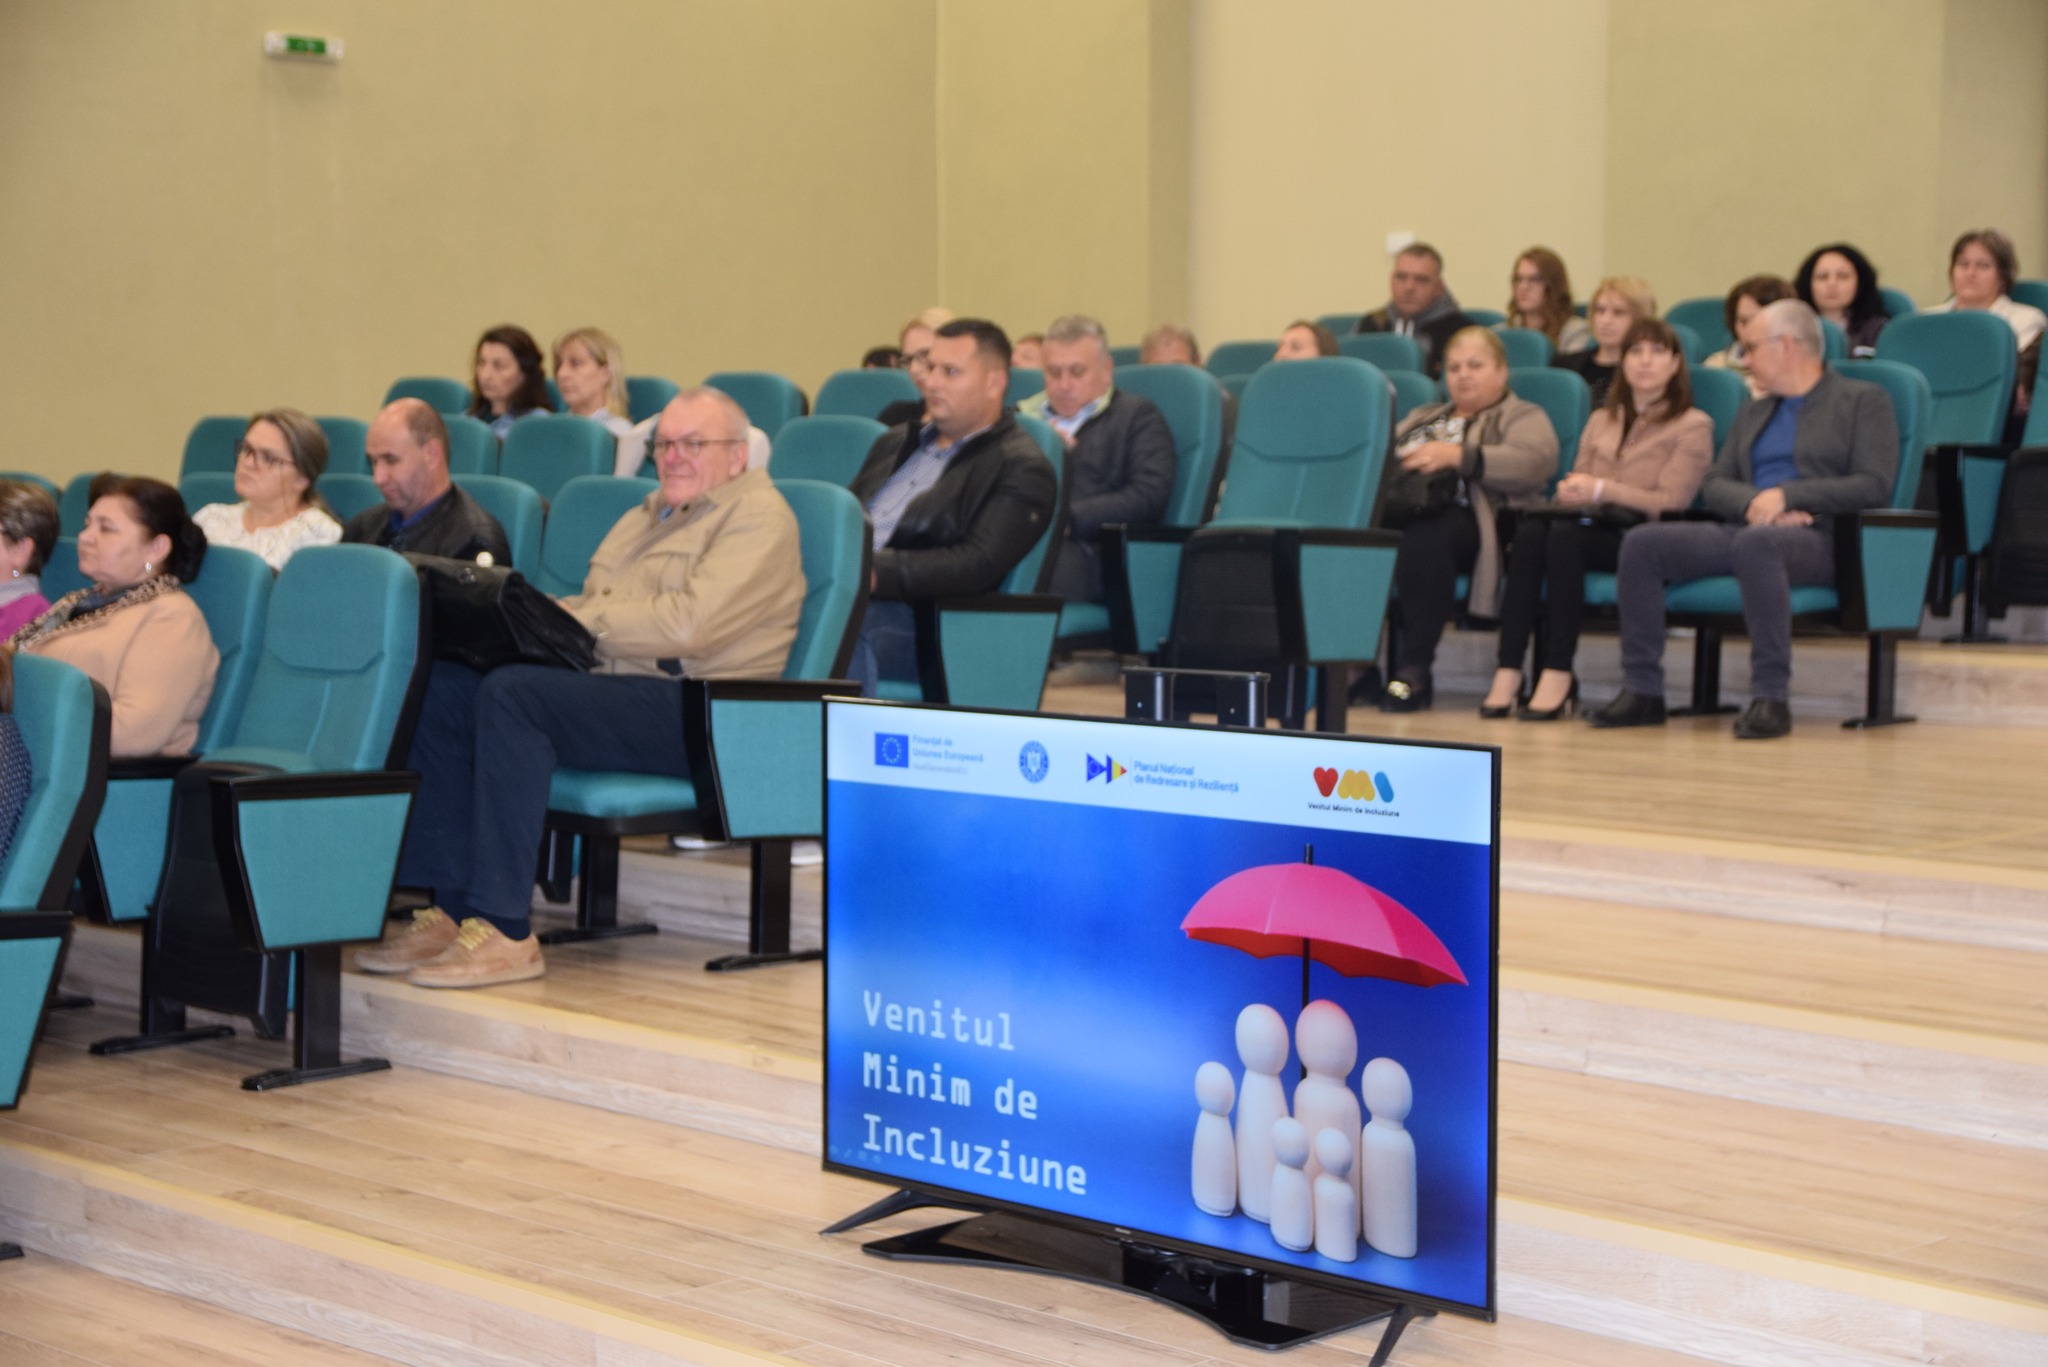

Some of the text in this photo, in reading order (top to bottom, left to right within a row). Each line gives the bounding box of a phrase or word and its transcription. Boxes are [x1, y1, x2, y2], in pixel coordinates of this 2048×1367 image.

[1134, 760, 1159, 772] Planul
[1134, 774, 1144, 783] de
[1145, 774, 1188, 787] Redresare
[1307, 802, 1331, 811] Venitul
[1332, 804, 1353, 813] Minim
[863, 990, 1015, 1050] Venitul
[863, 1051, 1038, 1120] Minim de
[863, 1113, 1087, 1195] Incluziune
